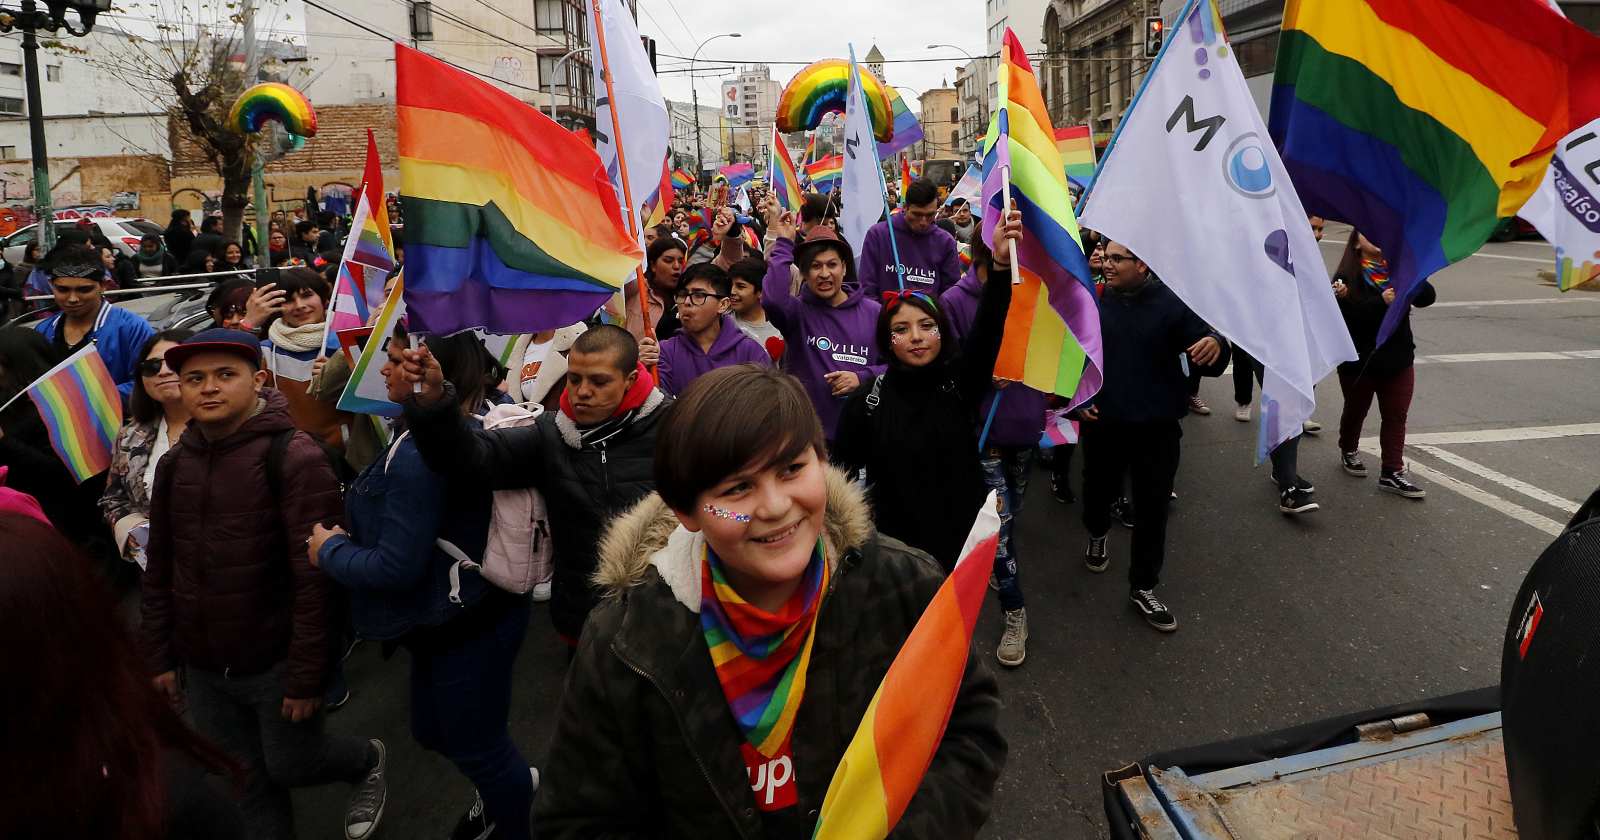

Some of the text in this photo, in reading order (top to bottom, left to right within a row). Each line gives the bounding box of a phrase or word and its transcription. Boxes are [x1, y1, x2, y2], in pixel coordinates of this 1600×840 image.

[885, 263, 936, 278] MOVILH
[806, 335, 869, 356] MOVILH
[746, 754, 796, 805] up
